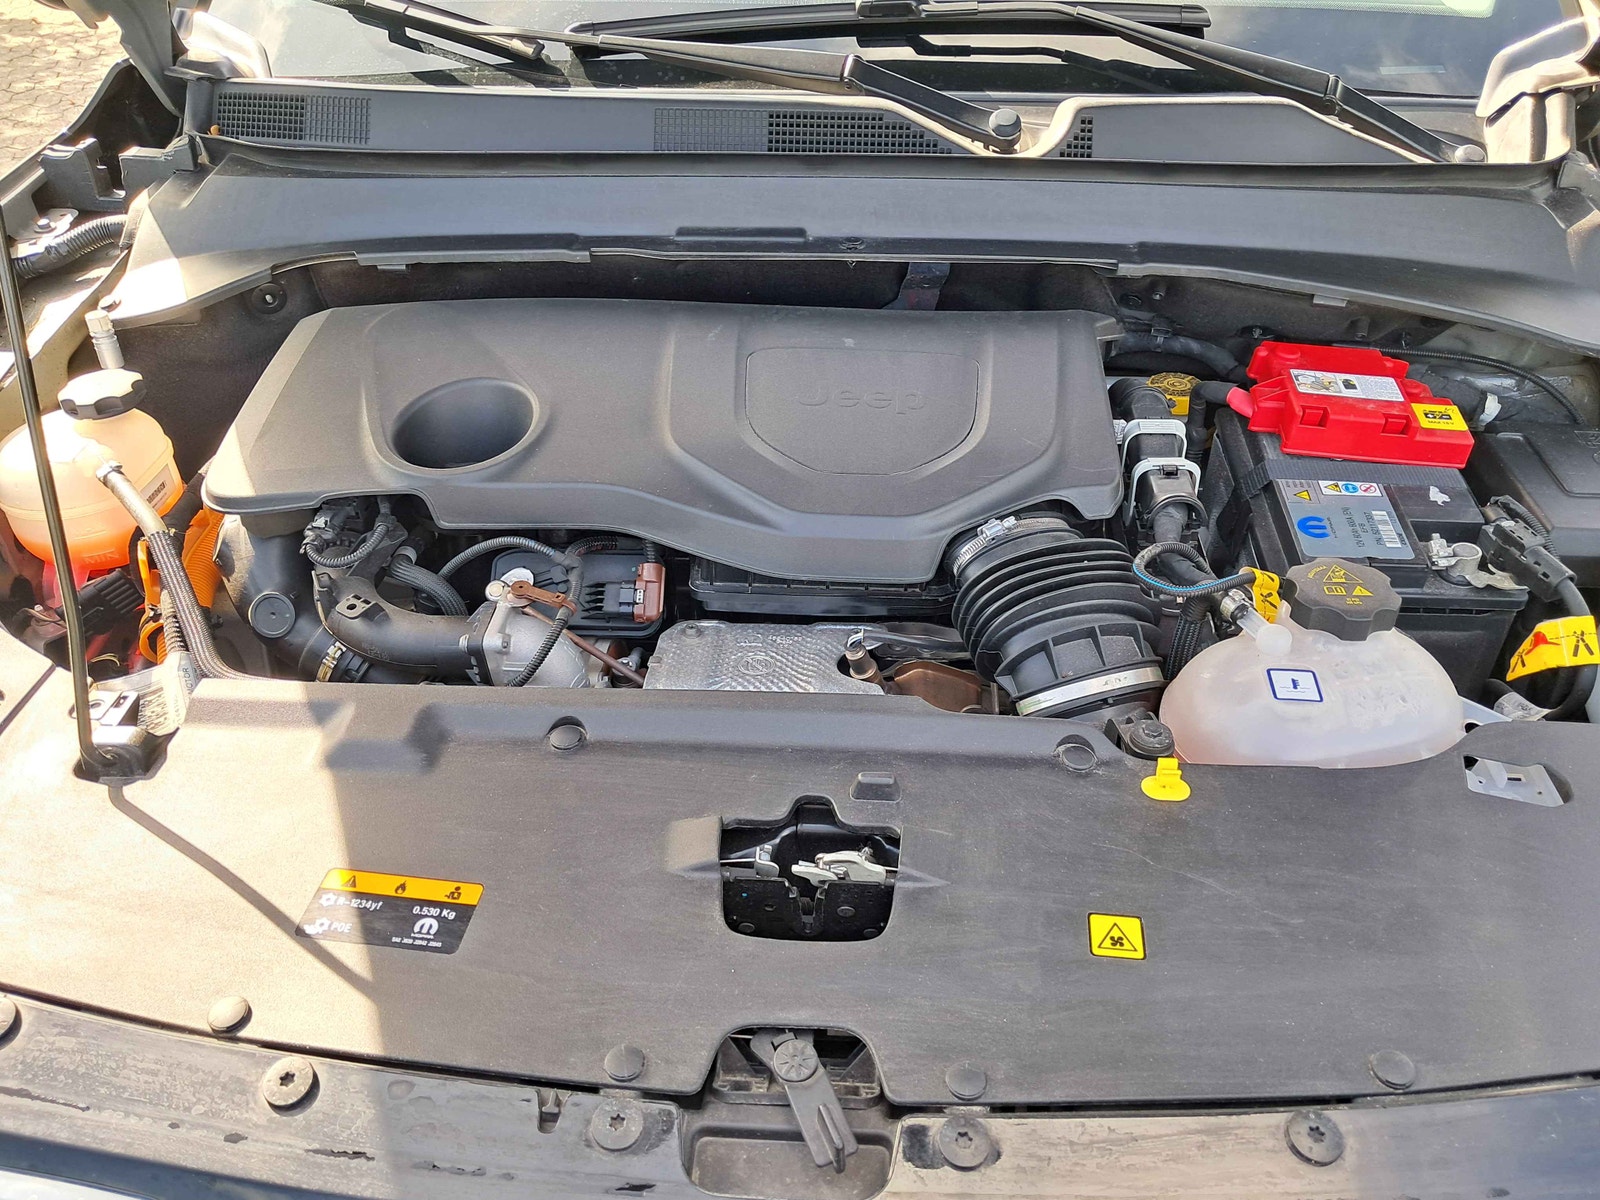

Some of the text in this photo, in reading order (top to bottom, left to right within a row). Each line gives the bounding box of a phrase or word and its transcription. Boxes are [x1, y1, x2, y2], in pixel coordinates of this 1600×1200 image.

[796, 381, 926, 415] Jeep
[412, 905, 456, 920] 0.530 Kg
[330, 922, 352, 934] POE
